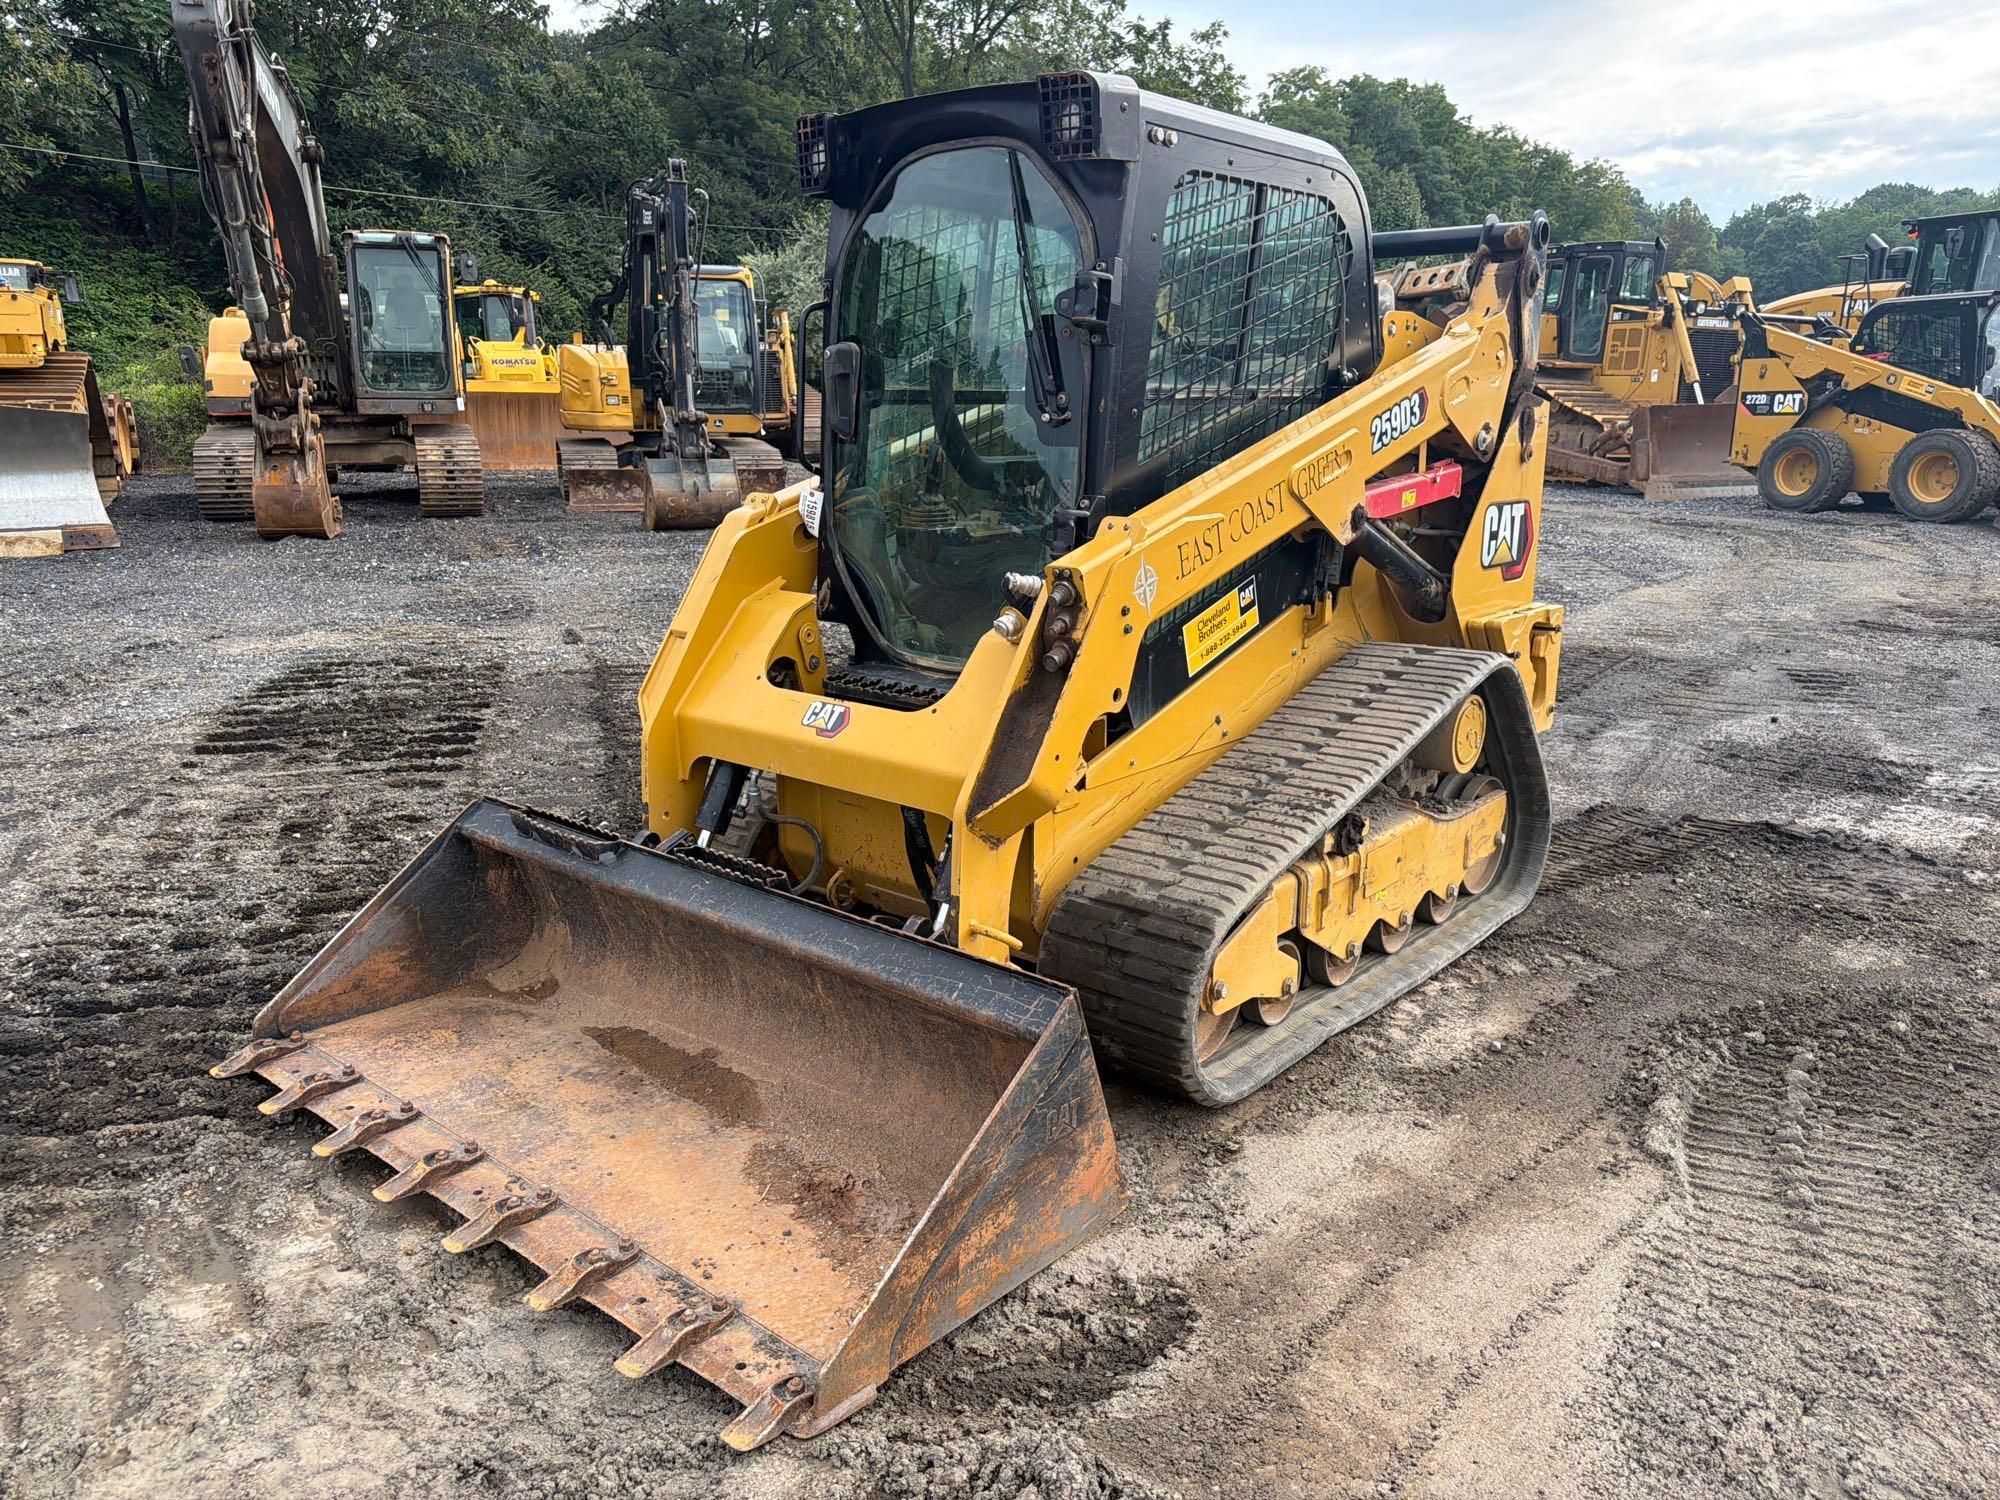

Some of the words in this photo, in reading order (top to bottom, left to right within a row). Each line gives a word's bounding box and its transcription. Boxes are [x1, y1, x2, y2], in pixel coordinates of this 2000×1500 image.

[1697, 319, 1729, 328] CATERPILLAR
[491, 357, 536, 365] KOMATSU
[1773, 393, 1803, 413] CAT
[1371, 392, 1420, 453] 259D3
[805, 499, 818, 531] 159815
[1228, 479, 1286, 543] COAST
[1481, 502, 1526, 567] CAT
[1239, 583, 1254, 608] CAT
[1197, 600, 1231, 632] Cleveland
[1198, 616, 1228, 643] Brothers
[1200, 619, 1248, 660] 1-888-232-5948
[802, 701, 846, 730] CAT
[1046, 1097, 1081, 1142] CAT
